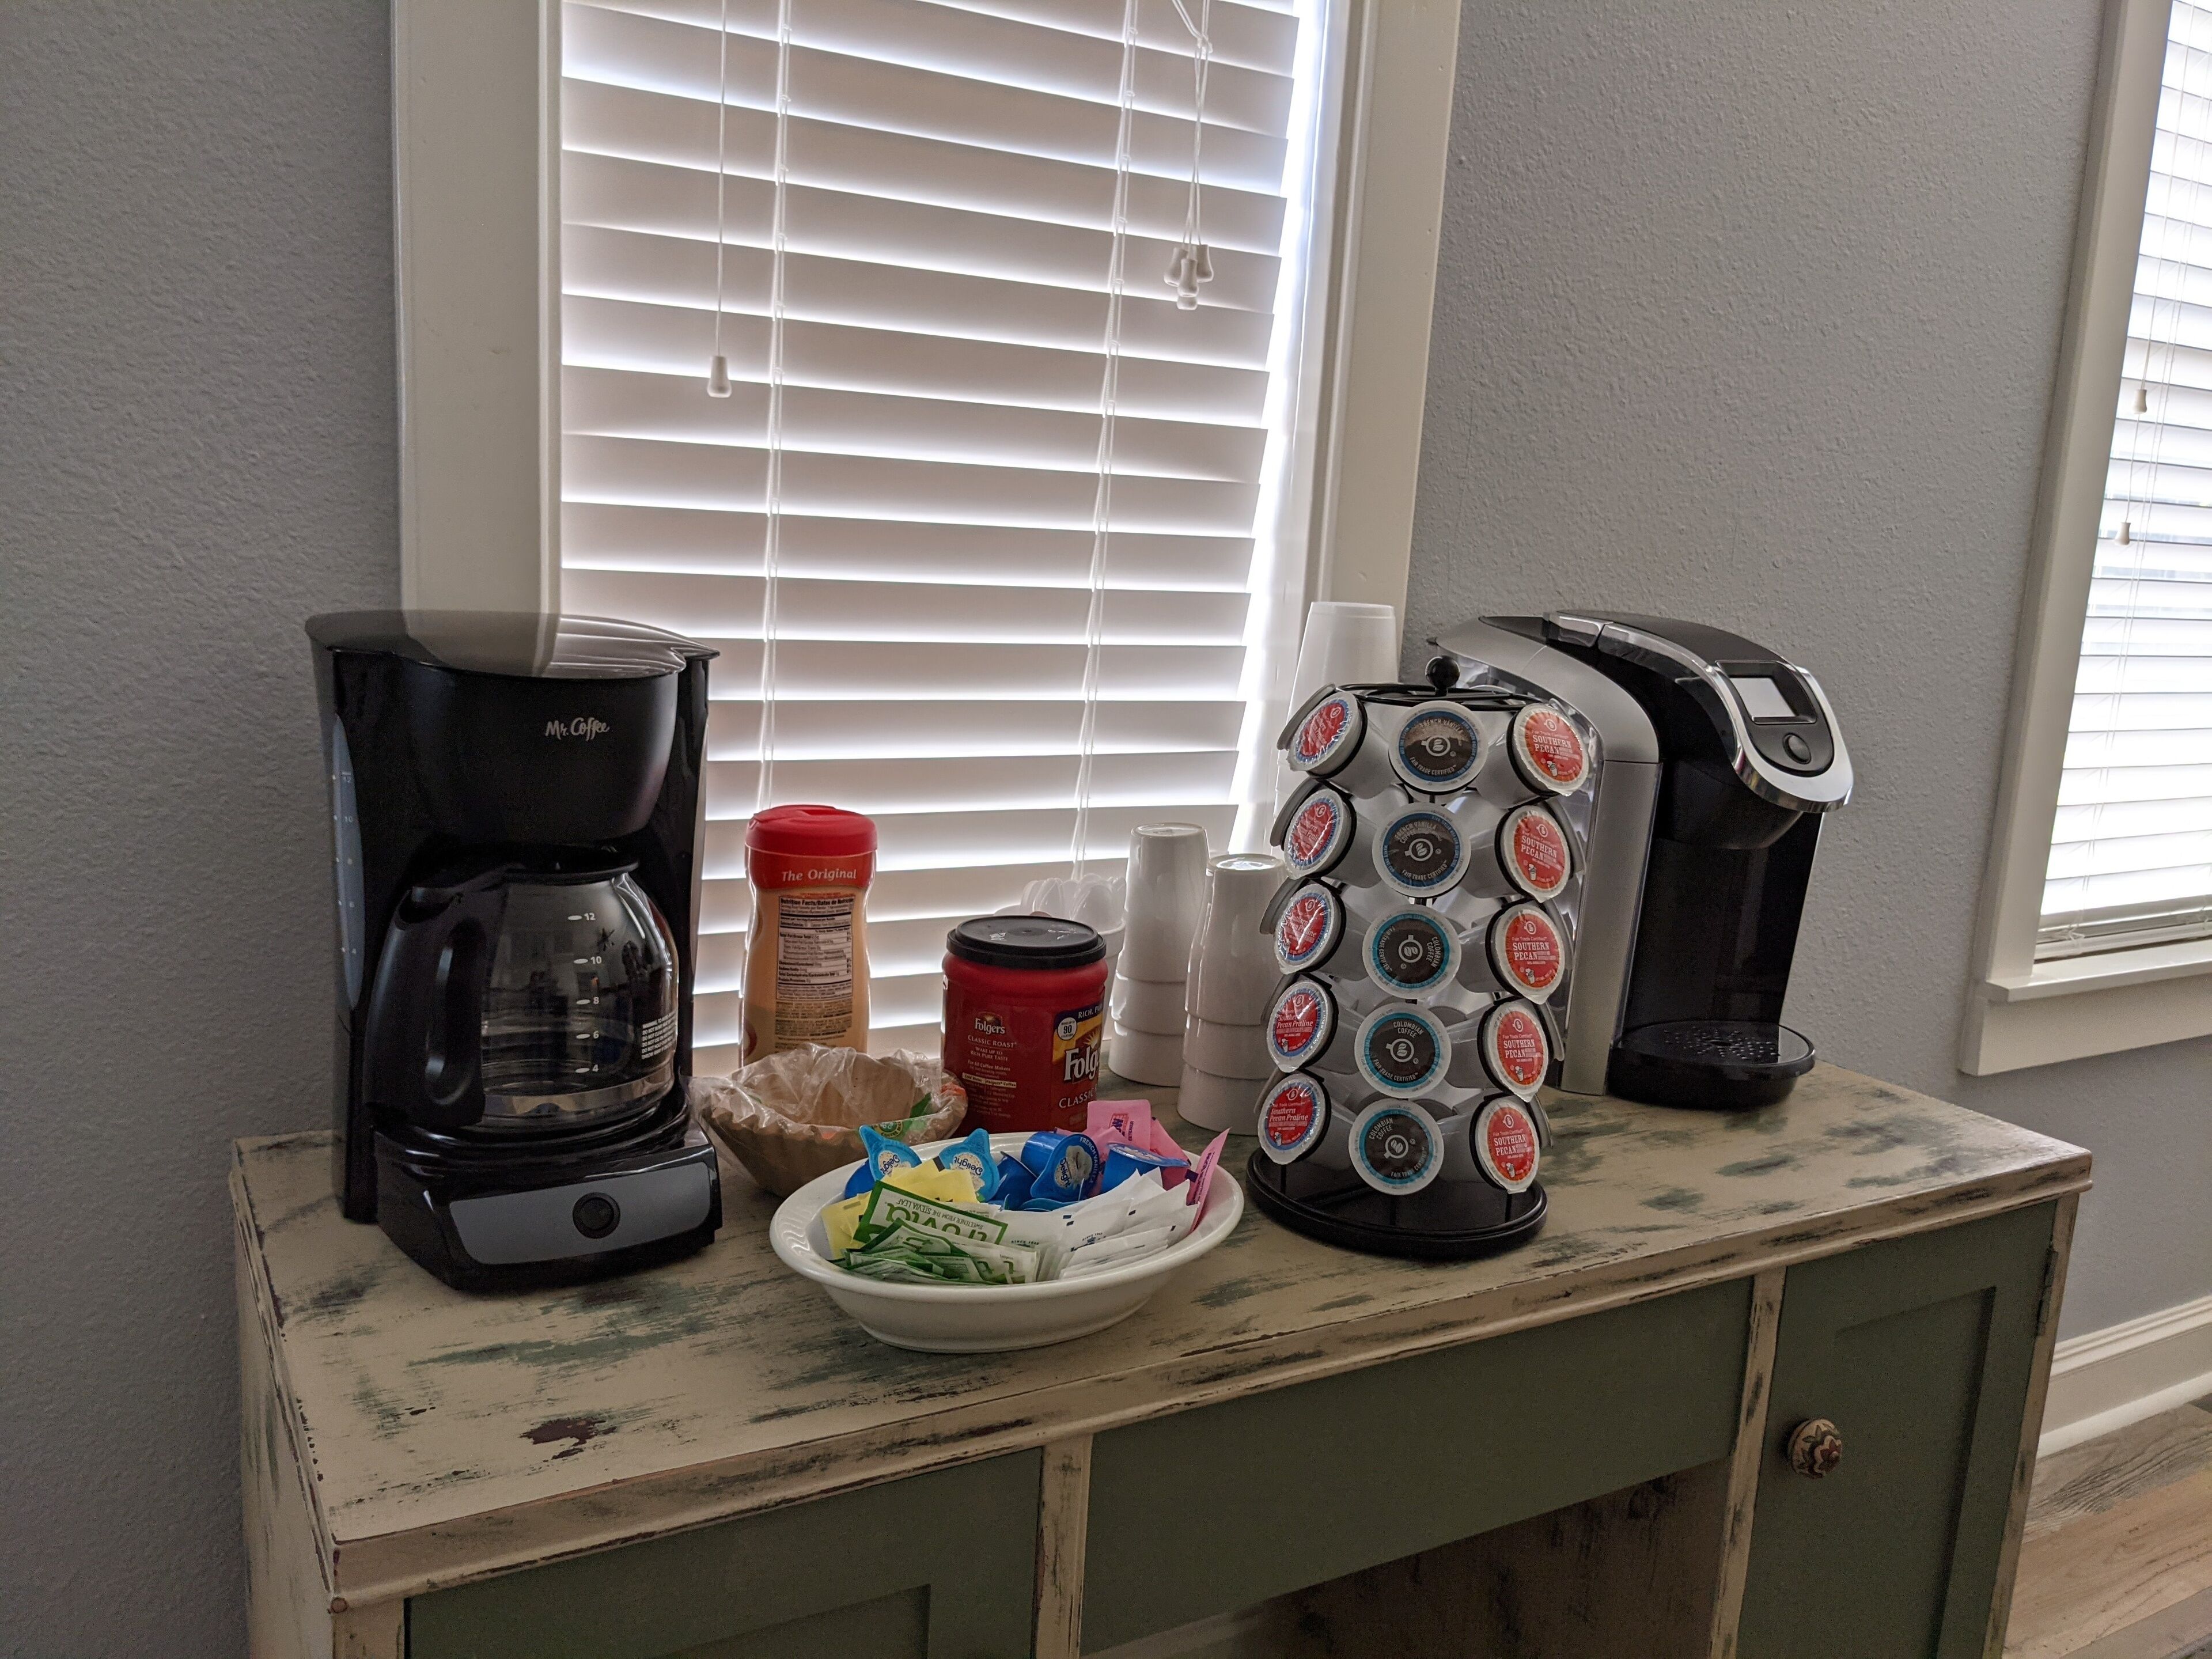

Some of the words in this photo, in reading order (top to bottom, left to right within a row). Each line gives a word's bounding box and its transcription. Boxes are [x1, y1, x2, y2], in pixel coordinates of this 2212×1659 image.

[545, 721, 569, 740] Mr.
[571, 717, 610, 741] Coffee
[1533, 735, 1571, 748] SOUTHERN
[1534, 744, 1560, 755] PECAN
[1410, 756, 1418, 768] FAIR
[1418, 765, 1431, 775] TRADE
[1521, 835, 1557, 858] SOUTHERN
[1521, 844, 1544, 861] PECAN
[782, 870, 802, 882] The
[808, 869, 857, 882] Original
[1402, 870, 1411, 878] FAIR
[1427, 864, 1448, 878] CERTIFIED
[584, 912, 596, 921] 12
[1298, 923, 1316, 937] Prine
[1426, 942, 1434, 963] COFFEE
[1431, 937, 1441, 968] COLOMBIAN
[1513, 942, 1550, 950] SOUTHERN
[590, 956, 602, 964] 10
[1379, 948, 1389, 971] CERTIFIED
[1514, 952, 1537, 960] PECAN
[593, 997, 599, 1005] 8
[975, 1018, 1005, 1035] Folgers
[1063, 1025, 1072, 1034] 90
[1393, 1021, 1423, 1035] COLOMBIAN
[1397, 1028, 1417, 1038] COFFEE
[593, 1031, 599, 1039] 6
[968, 1035, 991, 1044] CLASSIC
[1503, 1039, 1535, 1048] SOUTHERN
[1505, 1049, 1525, 1058] PECAN
[592, 1064, 599, 1072] 4
[1064, 1046, 1099, 1081] Folg
[1373, 1059, 1381, 1070] FAIR
[1380, 1069, 1393, 1080] TRADE
[1369, 1118, 1393, 1139] COLOMBIAN
[1376, 1124, 1393, 1139] COFFEE
[1080, 1137, 1097, 1156] FRENCH
[1494, 1134, 1526, 1146] SOUTHERN
[1496, 1145, 1516, 1156] PECAN
[880, 1154, 900, 1175] Delight
[953, 1156, 983, 1176] Delight
[1060, 1157, 1071, 1188] Delight
[896, 1198, 911, 1208] LEAF
[911, 1202, 932, 1214] STEVIA
[941, 1212, 956, 1221] FROM
[957, 1217, 983, 1230] SWEETENER
